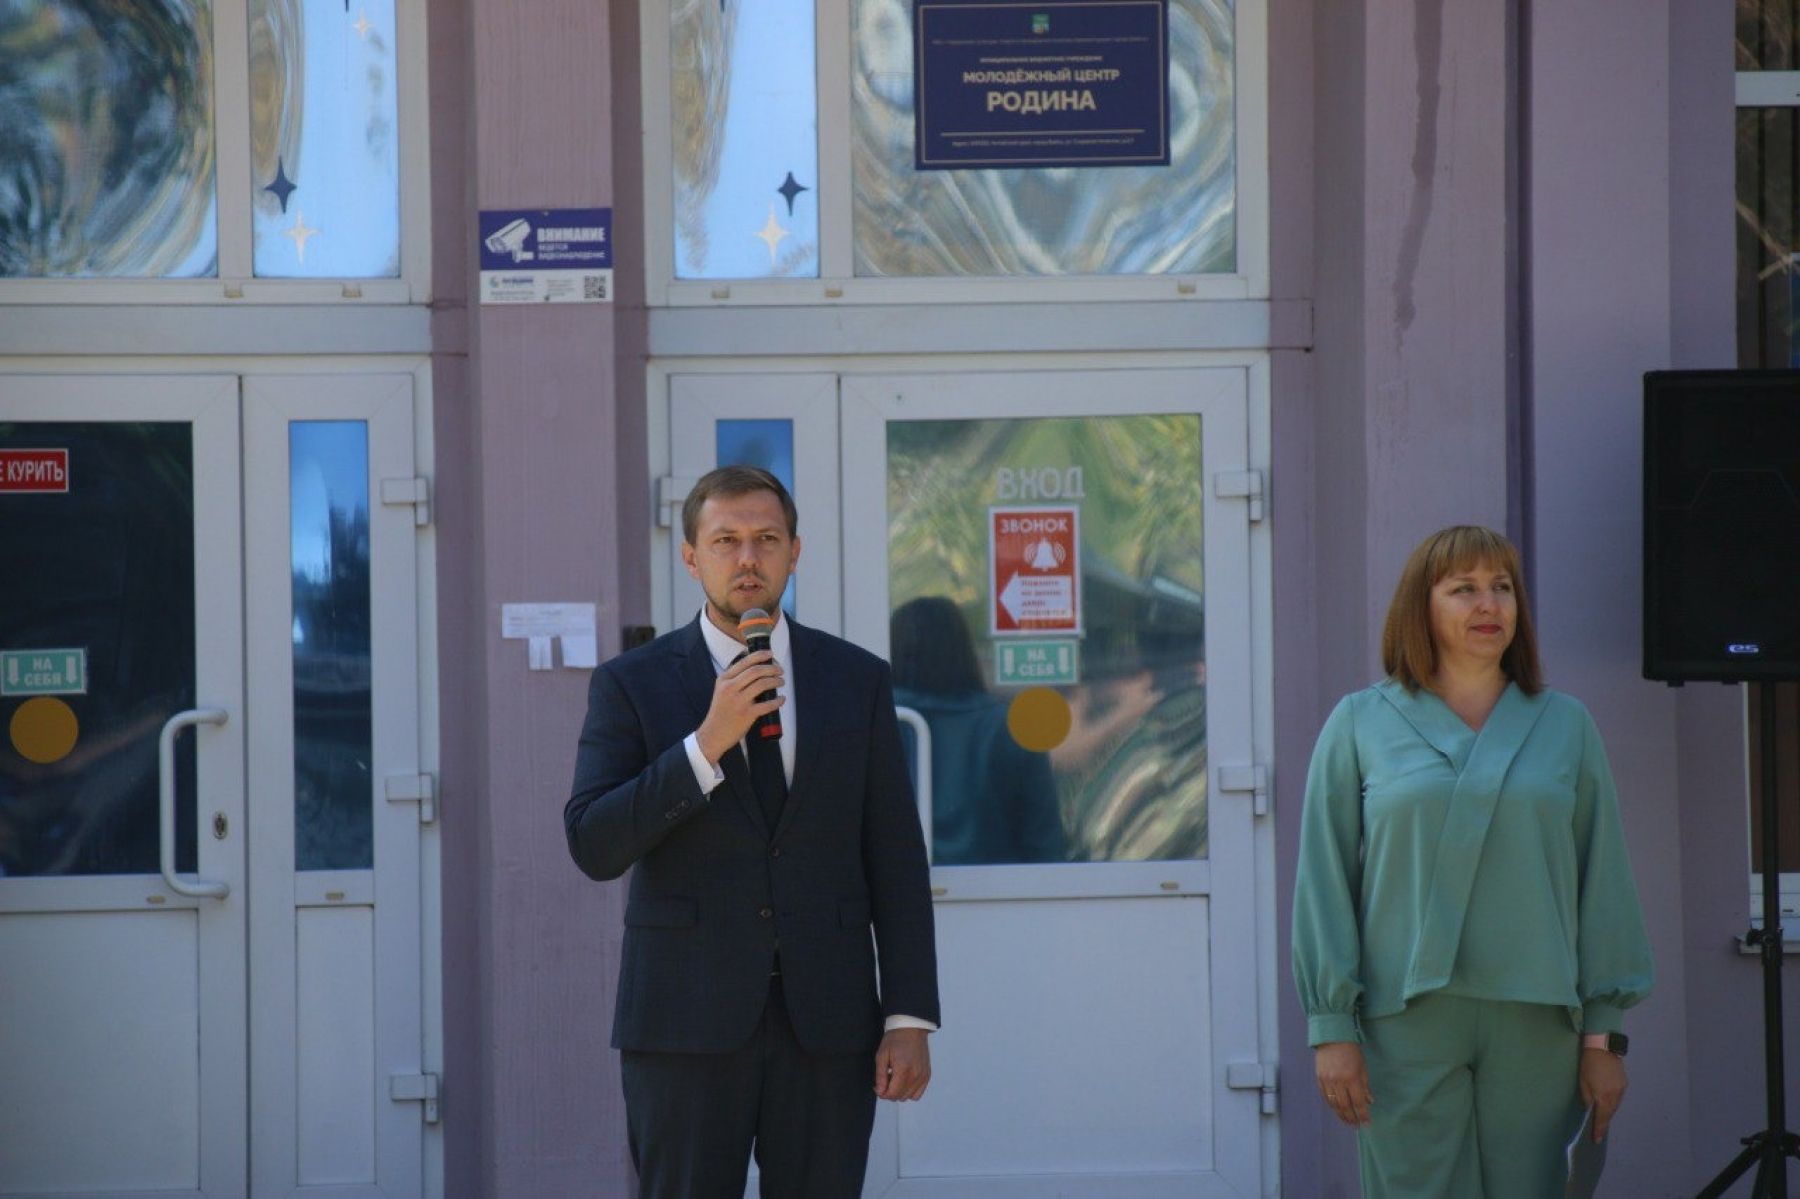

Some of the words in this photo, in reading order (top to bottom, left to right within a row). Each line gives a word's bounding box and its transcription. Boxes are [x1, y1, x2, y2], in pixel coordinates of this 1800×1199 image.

[963, 68, 1072, 84] МОЛОДЁЖНЫЙ
[1075, 68, 1121, 83] ЦЕНТР
[986, 90, 1097, 115] РОДИНА
[537, 227, 606, 242] ВНИМАНИЕ
[7, 461, 64, 482] КУРИТЬ
[998, 466, 1086, 500] ВХОД
[1001, 518, 1069, 533] ЗВОНОК
[1028, 649, 1047, 662] НА
[33, 657, 53, 671] НА
[1018, 662, 1056, 677] СЕБЯ
[24, 672, 62, 687] СЕБЯ
